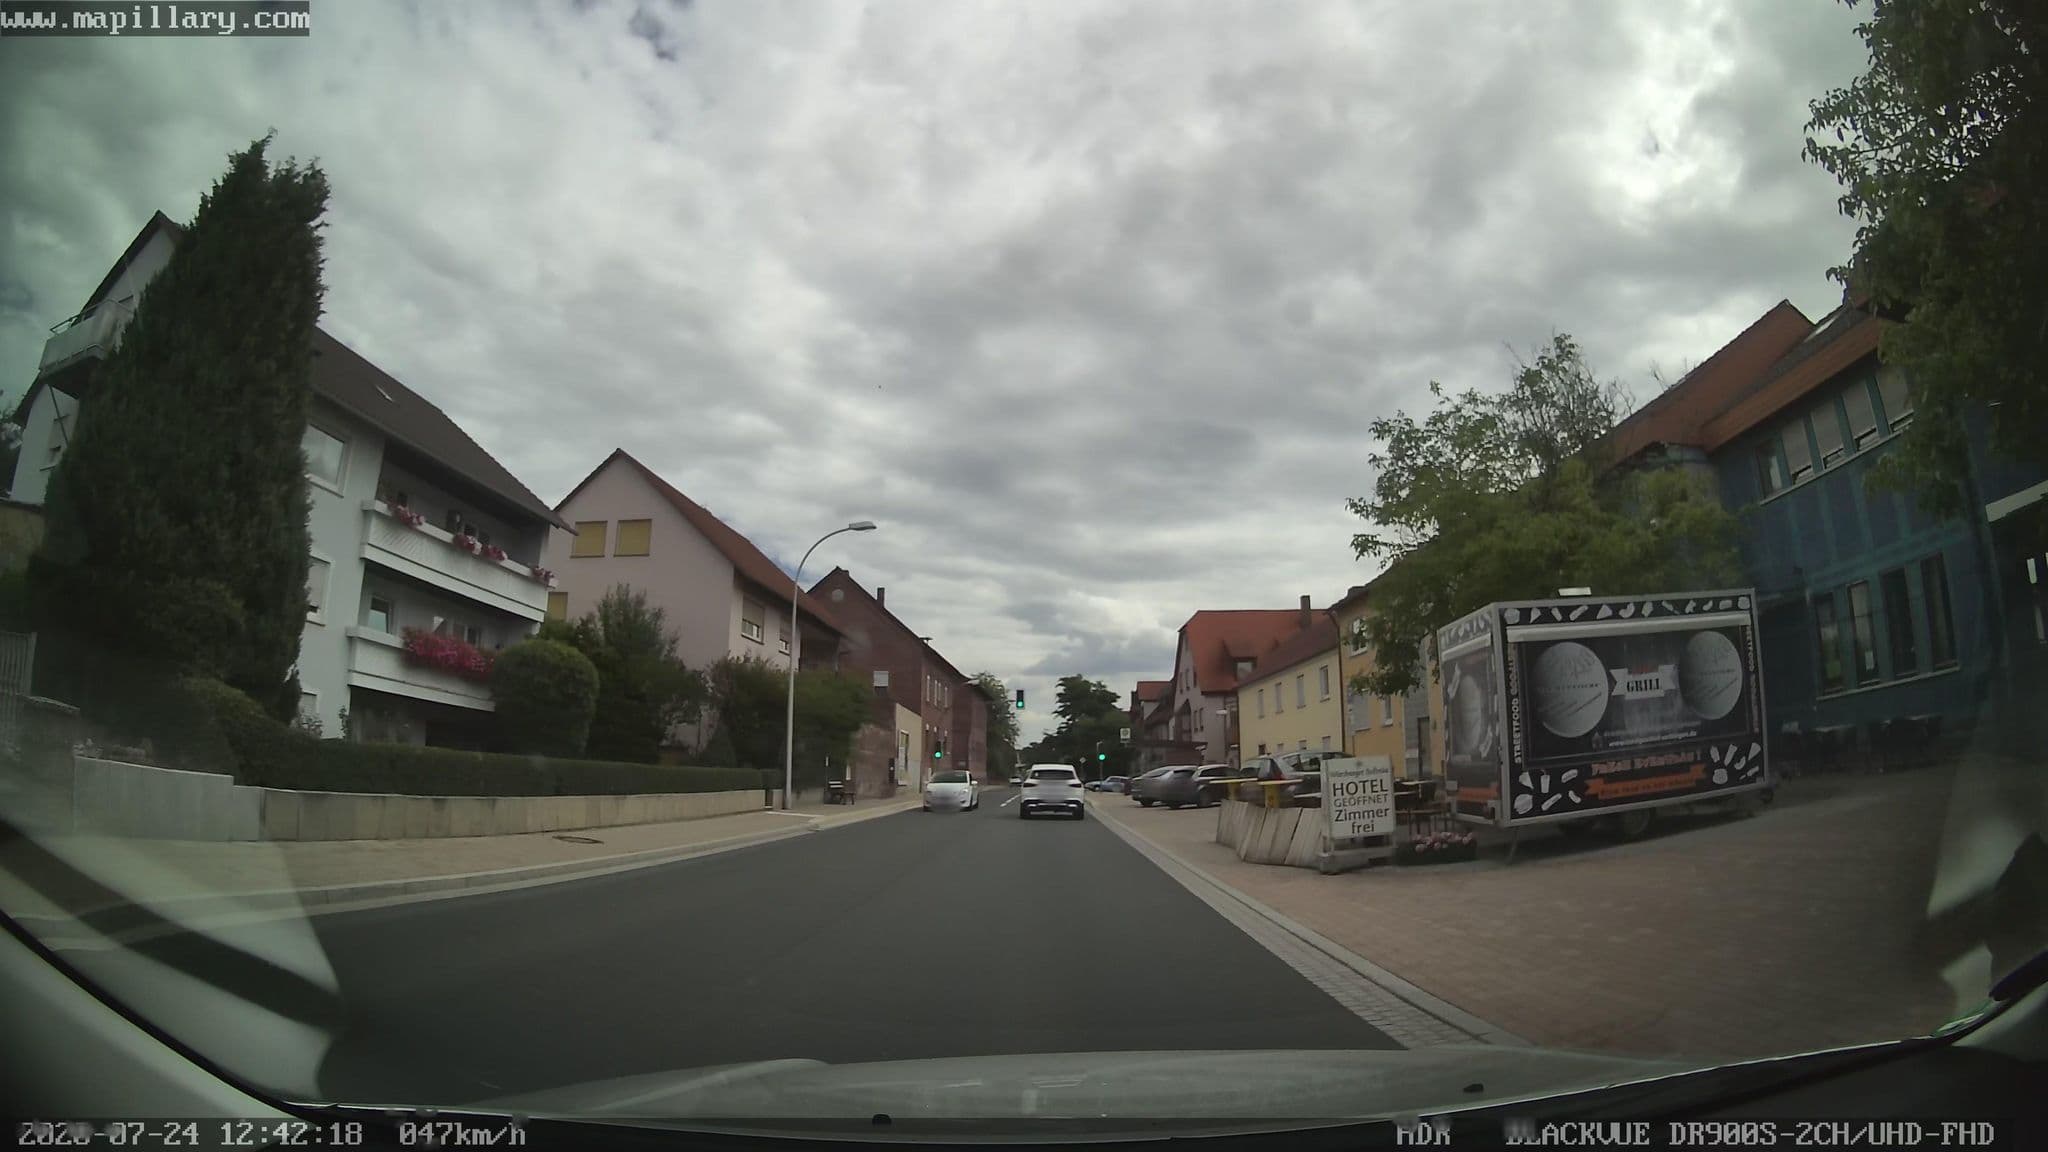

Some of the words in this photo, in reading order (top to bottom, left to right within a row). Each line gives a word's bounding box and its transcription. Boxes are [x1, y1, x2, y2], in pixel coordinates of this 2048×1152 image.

[1627, 678, 1659, 692] GRILL
[1511, 698, 1521, 764] STREETFOOD
[1333, 779, 1388, 796] HOTEL
[1335, 808, 1389, 822] Zimmer
[1352, 820, 1374, 834] frei
